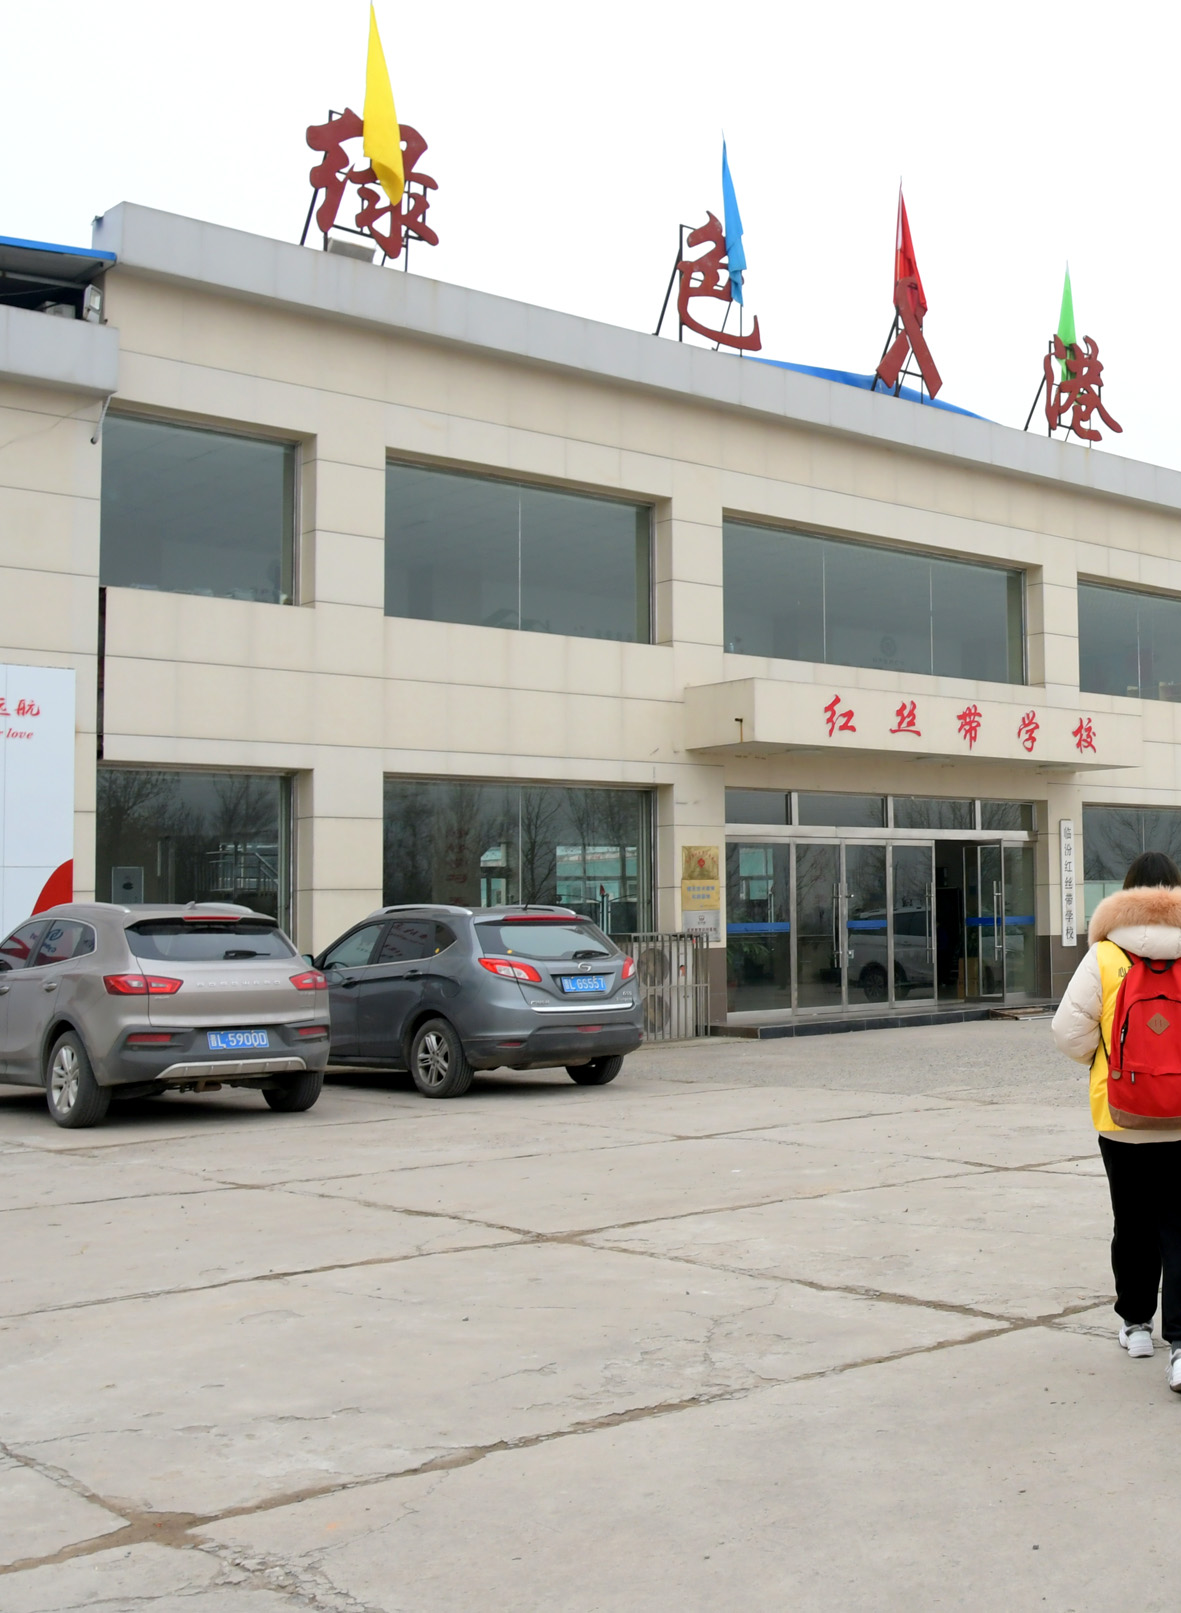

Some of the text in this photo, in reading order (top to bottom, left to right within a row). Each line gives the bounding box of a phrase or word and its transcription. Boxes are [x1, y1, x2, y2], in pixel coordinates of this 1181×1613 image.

[6, 728, 34, 739] love
[824, 694, 1097, 753] 红丝带学校
[1063, 826, 1075, 940] 临汾红丝带学校
